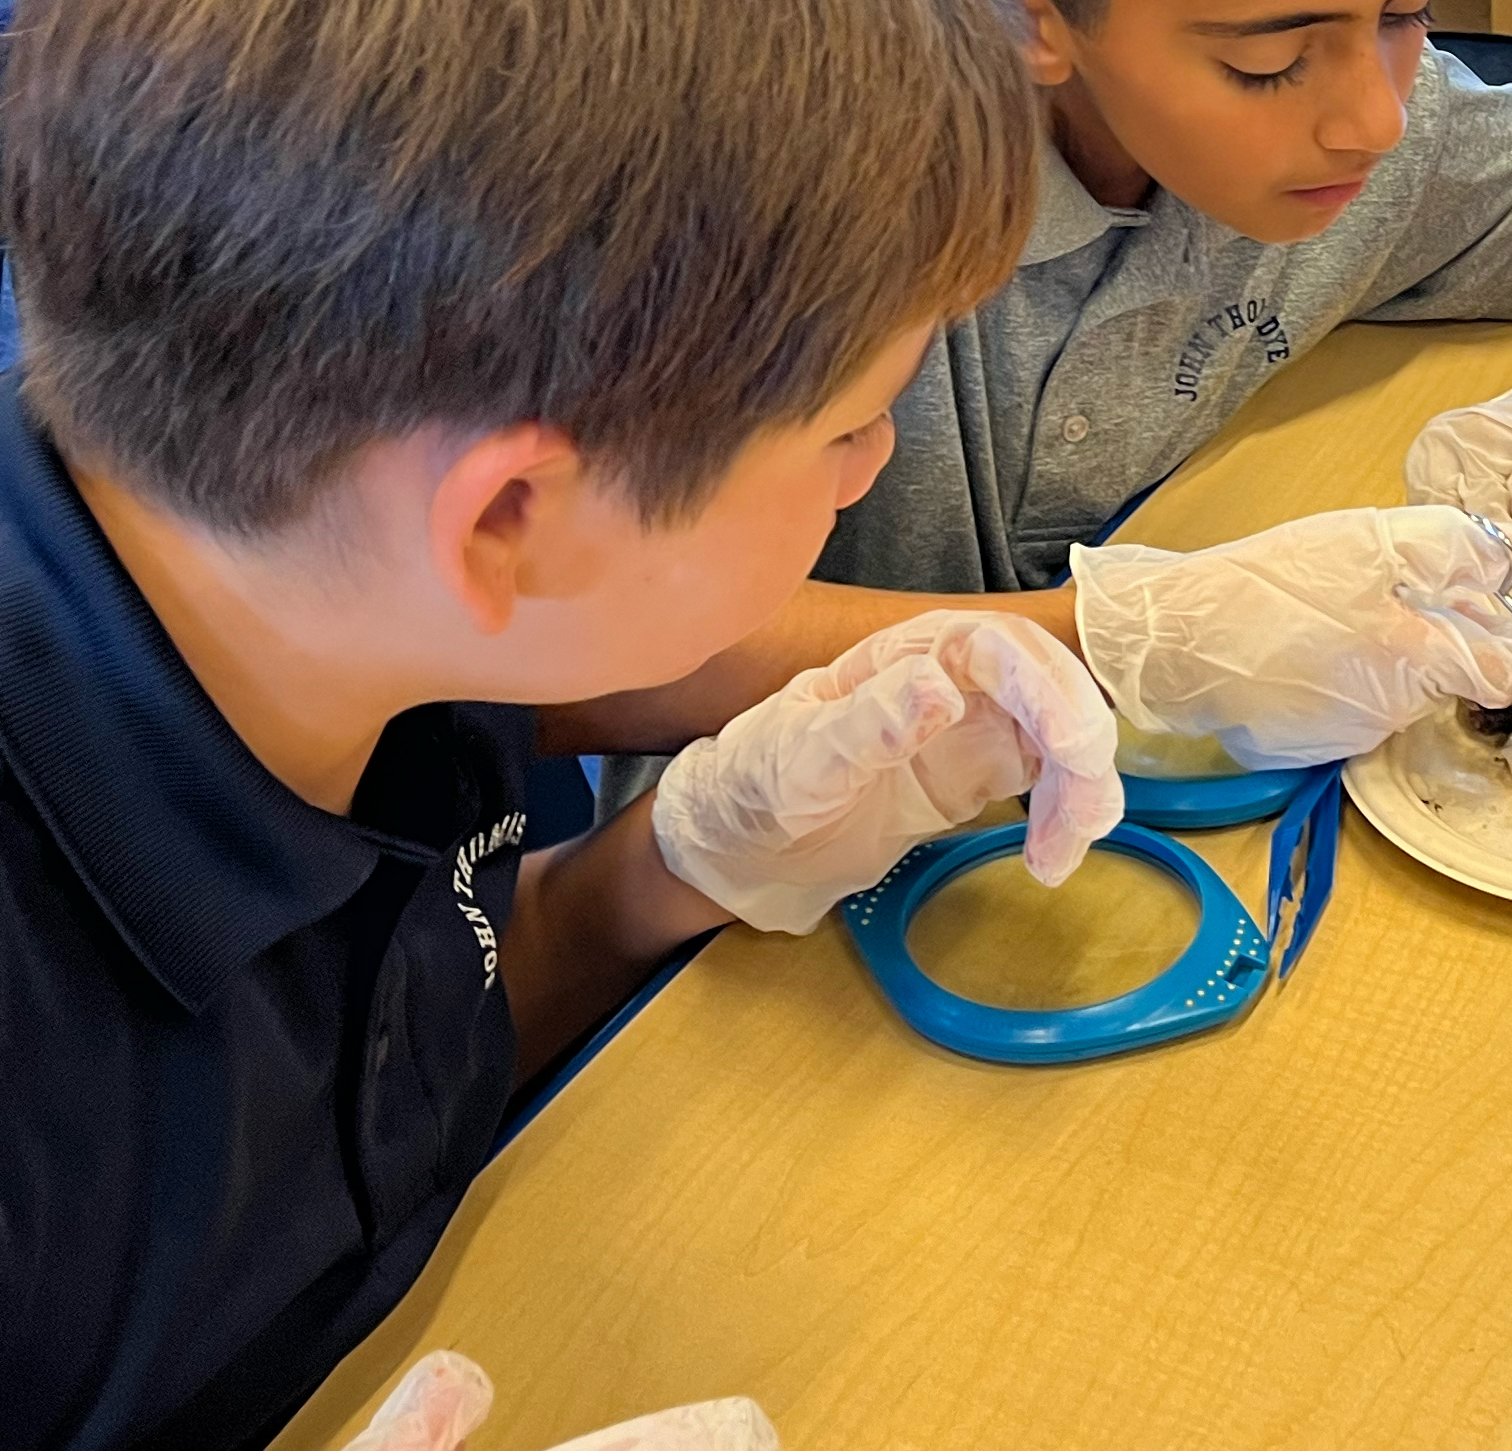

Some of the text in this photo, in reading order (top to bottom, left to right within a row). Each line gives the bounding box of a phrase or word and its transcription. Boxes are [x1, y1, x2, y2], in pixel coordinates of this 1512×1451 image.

[1174, 298, 1291, 402] JOHN THO DYE
